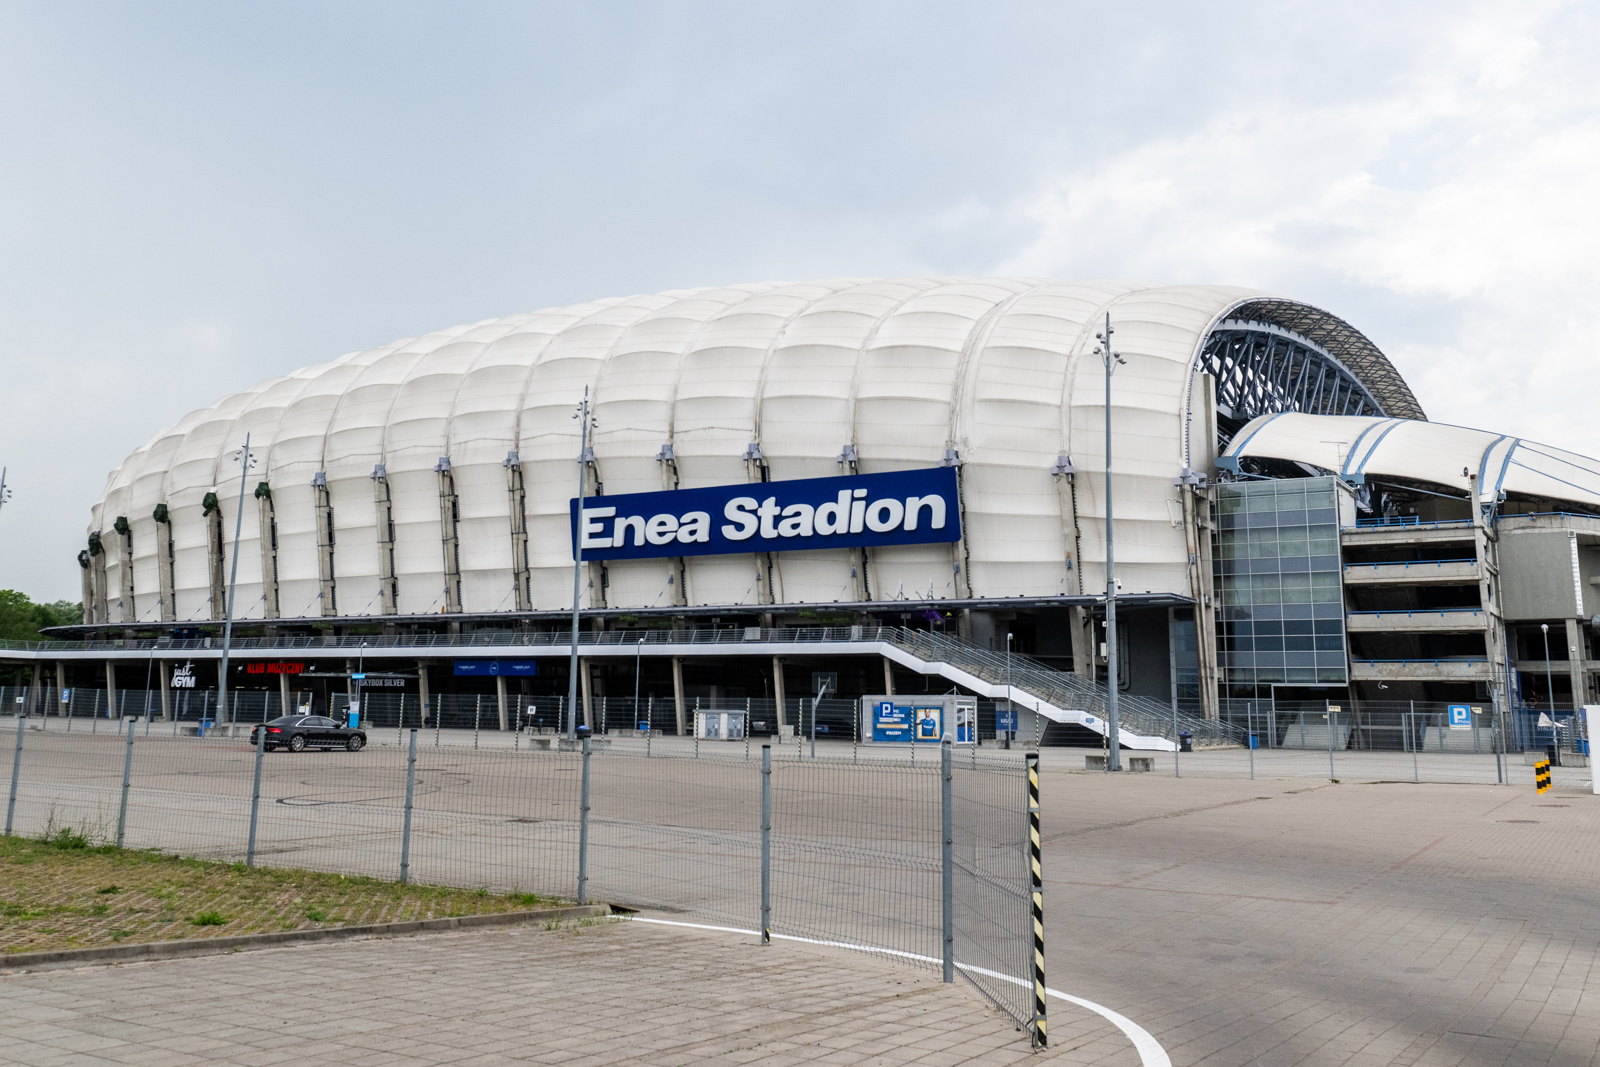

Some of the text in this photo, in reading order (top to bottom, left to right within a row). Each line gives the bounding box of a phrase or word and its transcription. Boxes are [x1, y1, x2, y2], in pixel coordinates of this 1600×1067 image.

[581, 488, 946, 549] Enea Stadion
[247, 662, 304, 673] KLUB MUZYCZNY
[174, 676, 196, 687] GYM
[360, 679, 405, 687] SKYBOX SILVER
[882, 703, 891, 717] P
[1453, 708, 1466, 723] P
